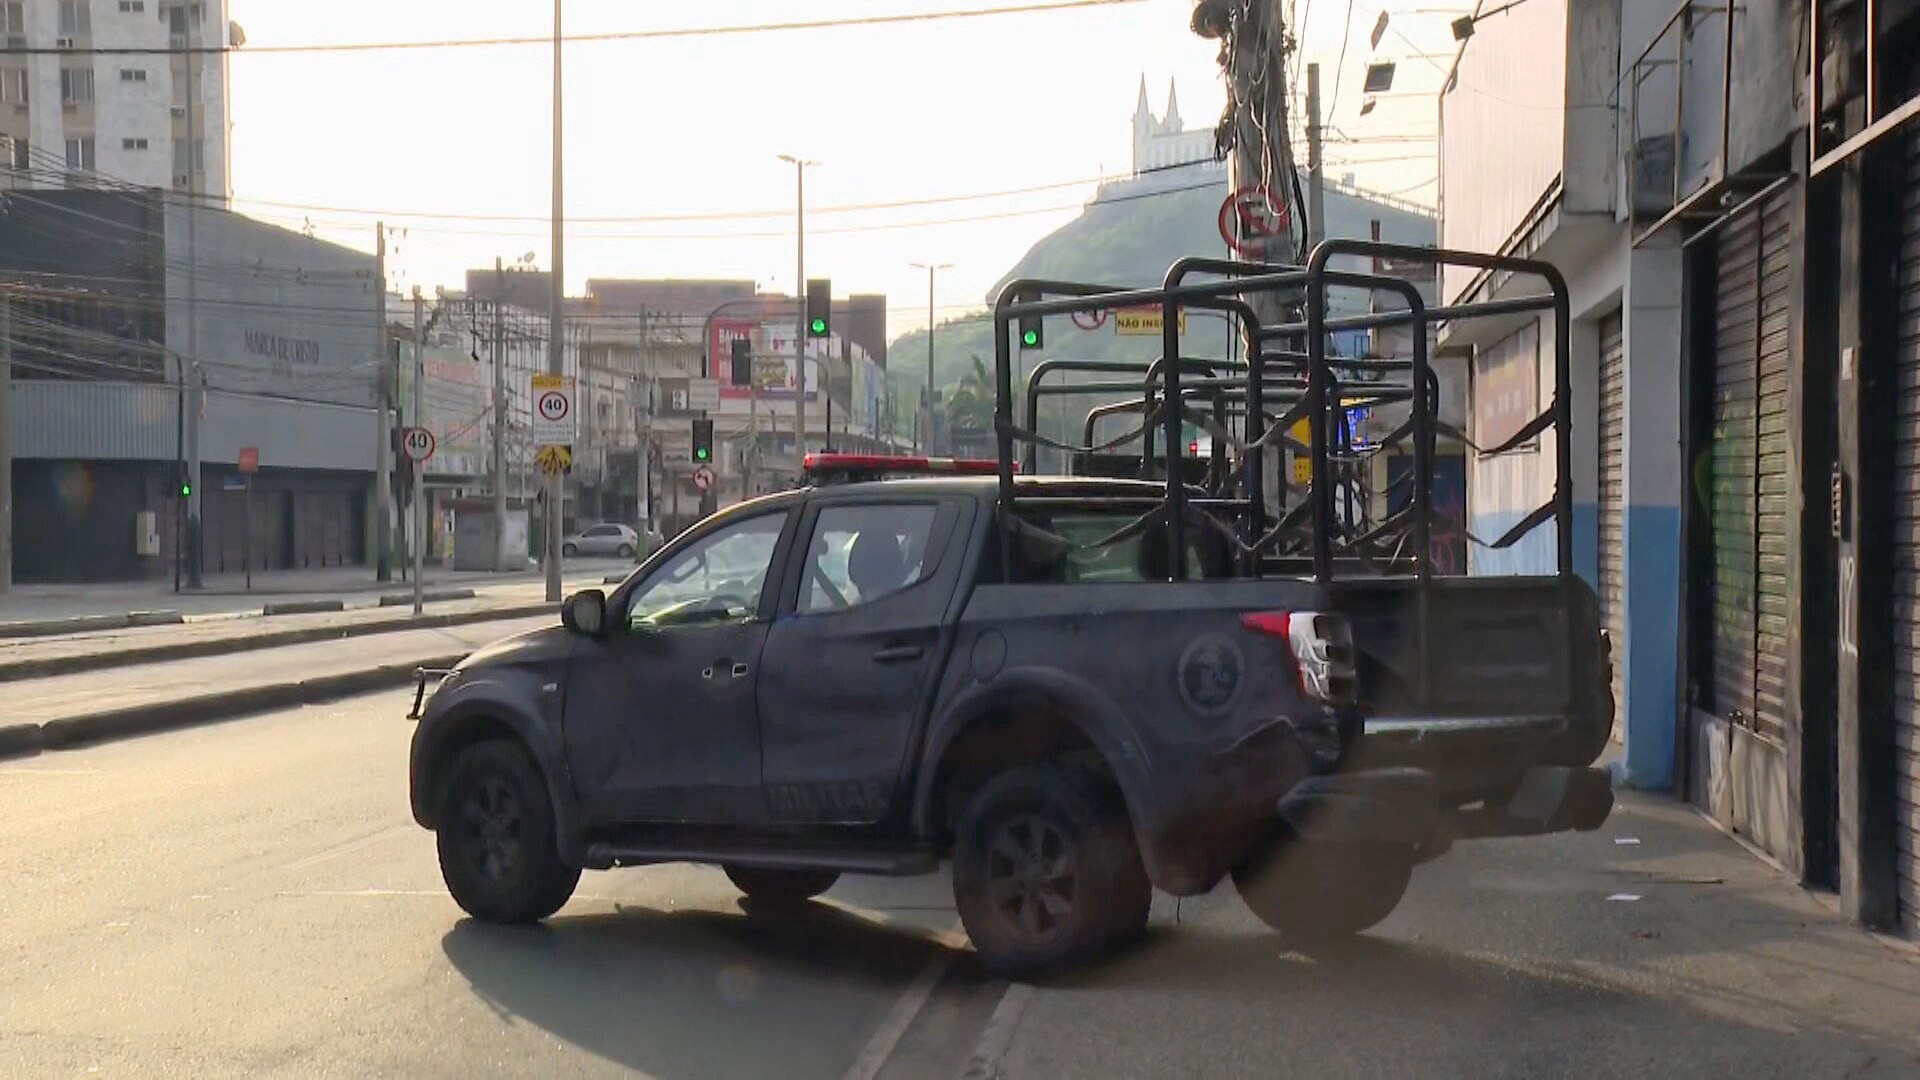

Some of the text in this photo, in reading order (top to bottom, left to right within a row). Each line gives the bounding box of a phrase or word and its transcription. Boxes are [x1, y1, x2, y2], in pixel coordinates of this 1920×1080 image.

[1117, 317, 1139, 329] NÃO
[544, 398, 562, 411] 40
[408, 432, 428, 449] 40
[767, 783, 890, 813] MILITAR
